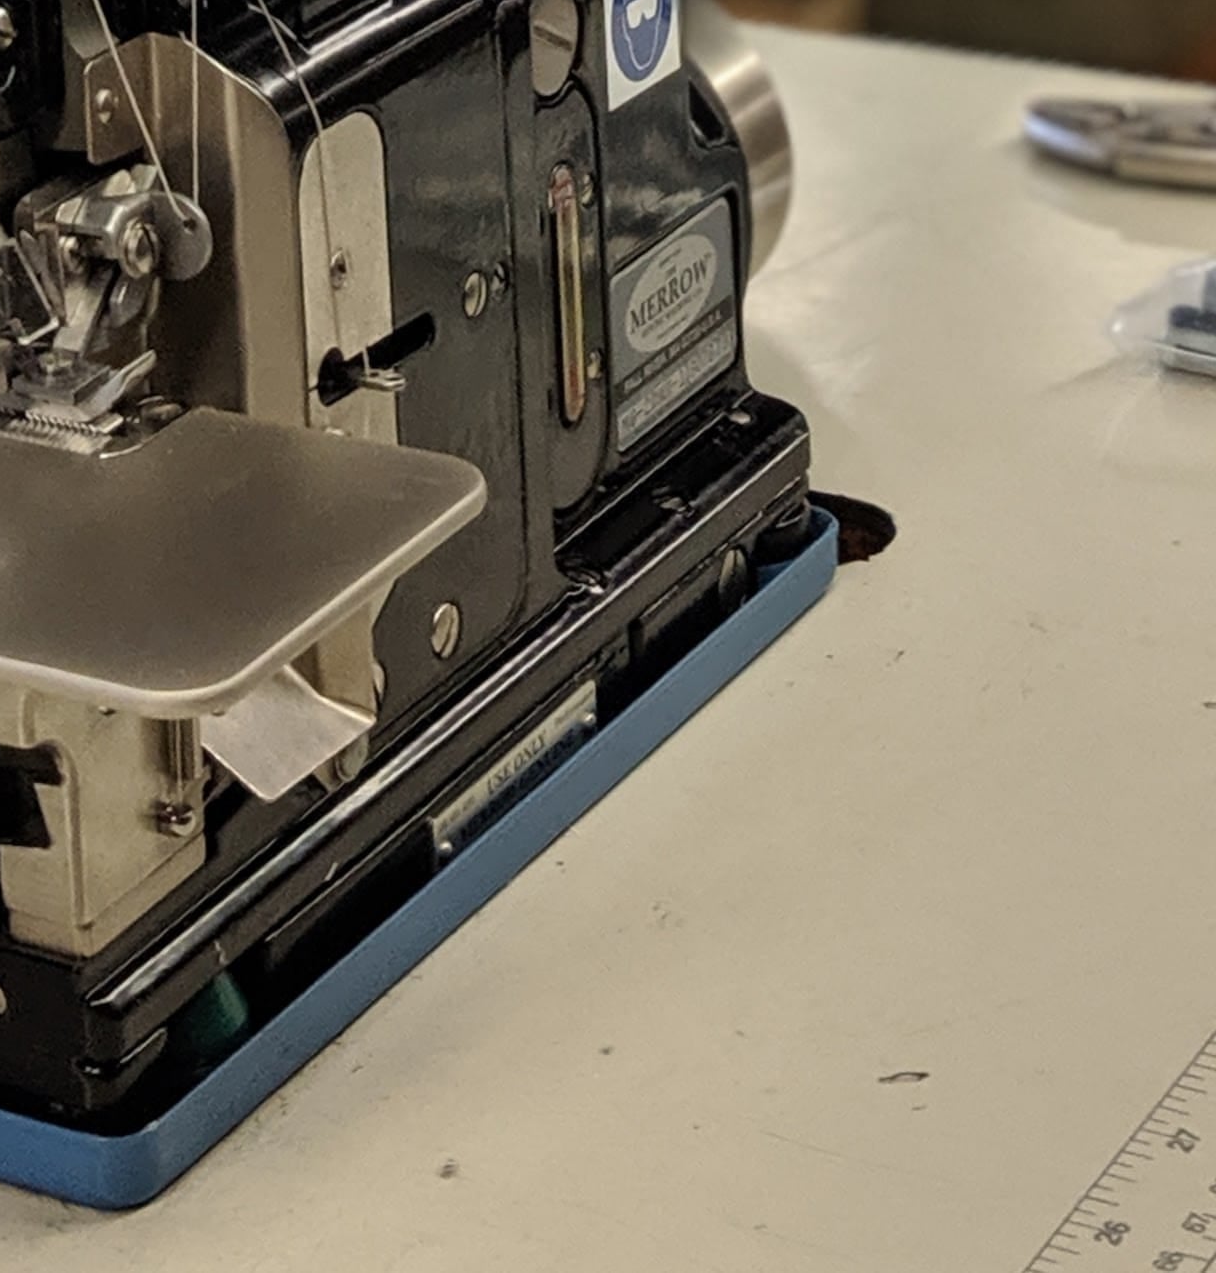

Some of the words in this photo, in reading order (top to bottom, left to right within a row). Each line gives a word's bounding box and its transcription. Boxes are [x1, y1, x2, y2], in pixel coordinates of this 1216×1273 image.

[630, 259, 707, 333] MERROW
[1165, 1127, 1201, 1153] 27
[1093, 1220, 1131, 1246] 26
